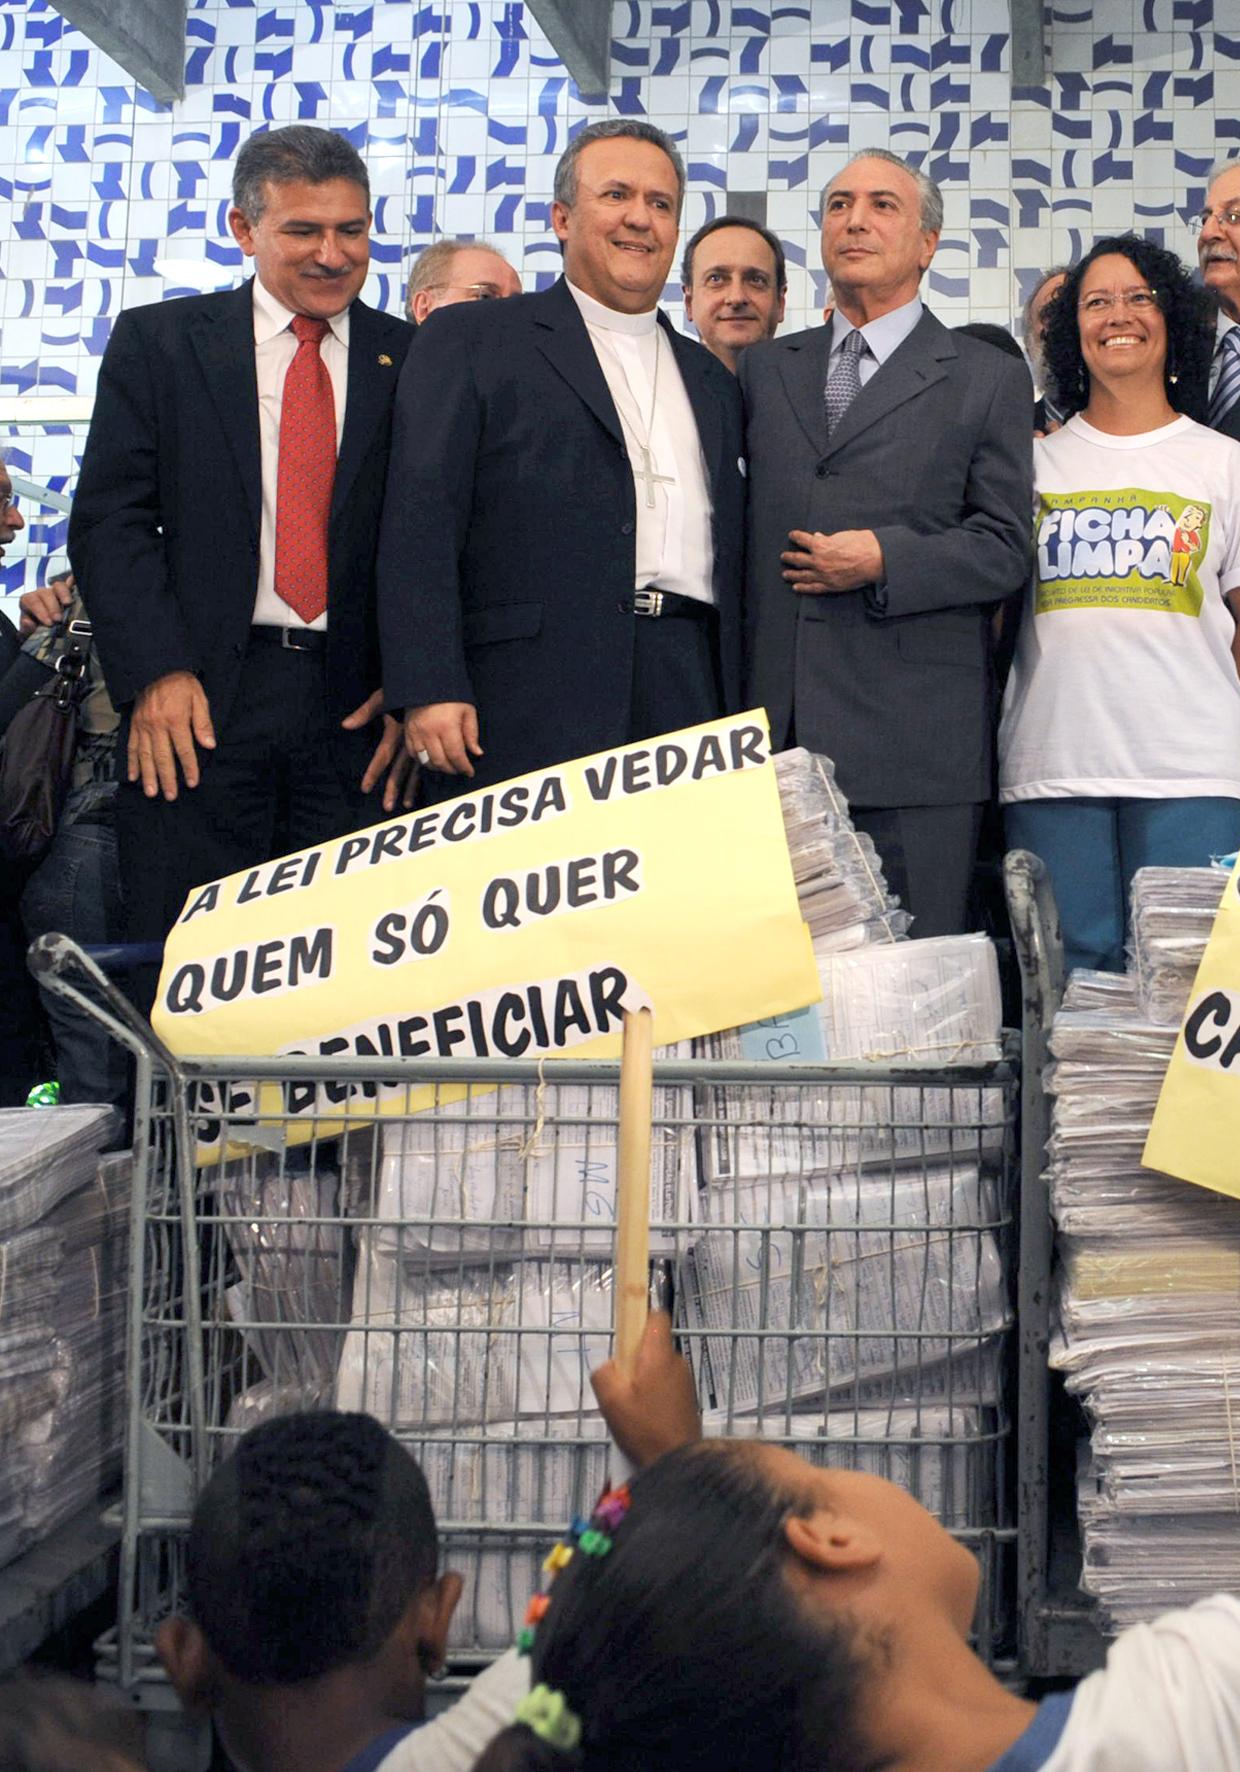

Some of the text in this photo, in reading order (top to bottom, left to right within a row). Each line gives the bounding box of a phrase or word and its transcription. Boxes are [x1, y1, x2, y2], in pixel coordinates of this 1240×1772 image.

[1037, 506, 1176, 546] FICHA
[1050, 495, 1137, 505] AMPANHA
[1037, 539, 1171, 582] LIMPA
[183, 726, 766, 923] A LEI PRECISA VEDAR
[166, 849, 640, 1013] QUEM SÓ QUER
[282, 967, 627, 1113] BENEFICIAR
